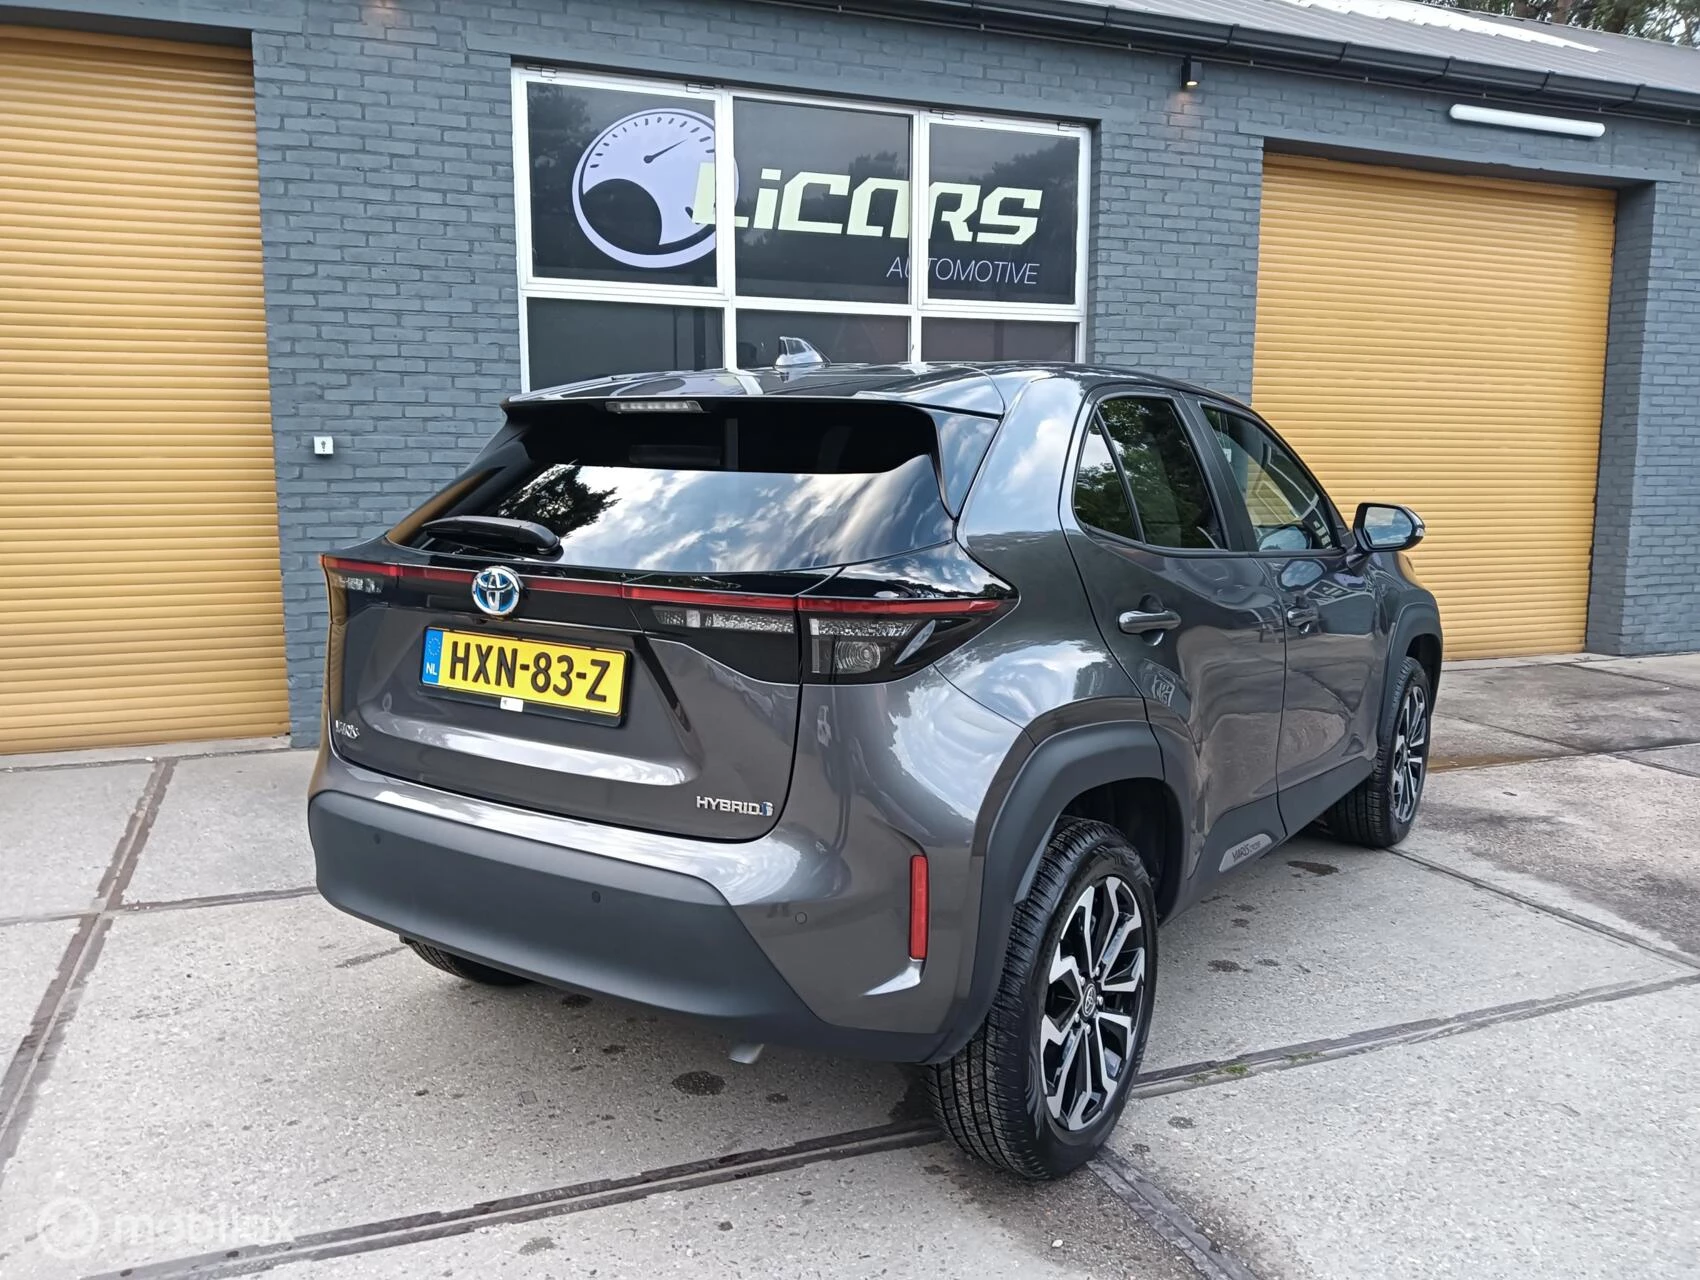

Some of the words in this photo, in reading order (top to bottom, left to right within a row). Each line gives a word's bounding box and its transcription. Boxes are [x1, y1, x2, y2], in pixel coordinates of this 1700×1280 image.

[425, 662, 438, 676] NL
[449, 641, 611, 703] HXN-83-Z
[696, 796, 761, 815] HYBRID
